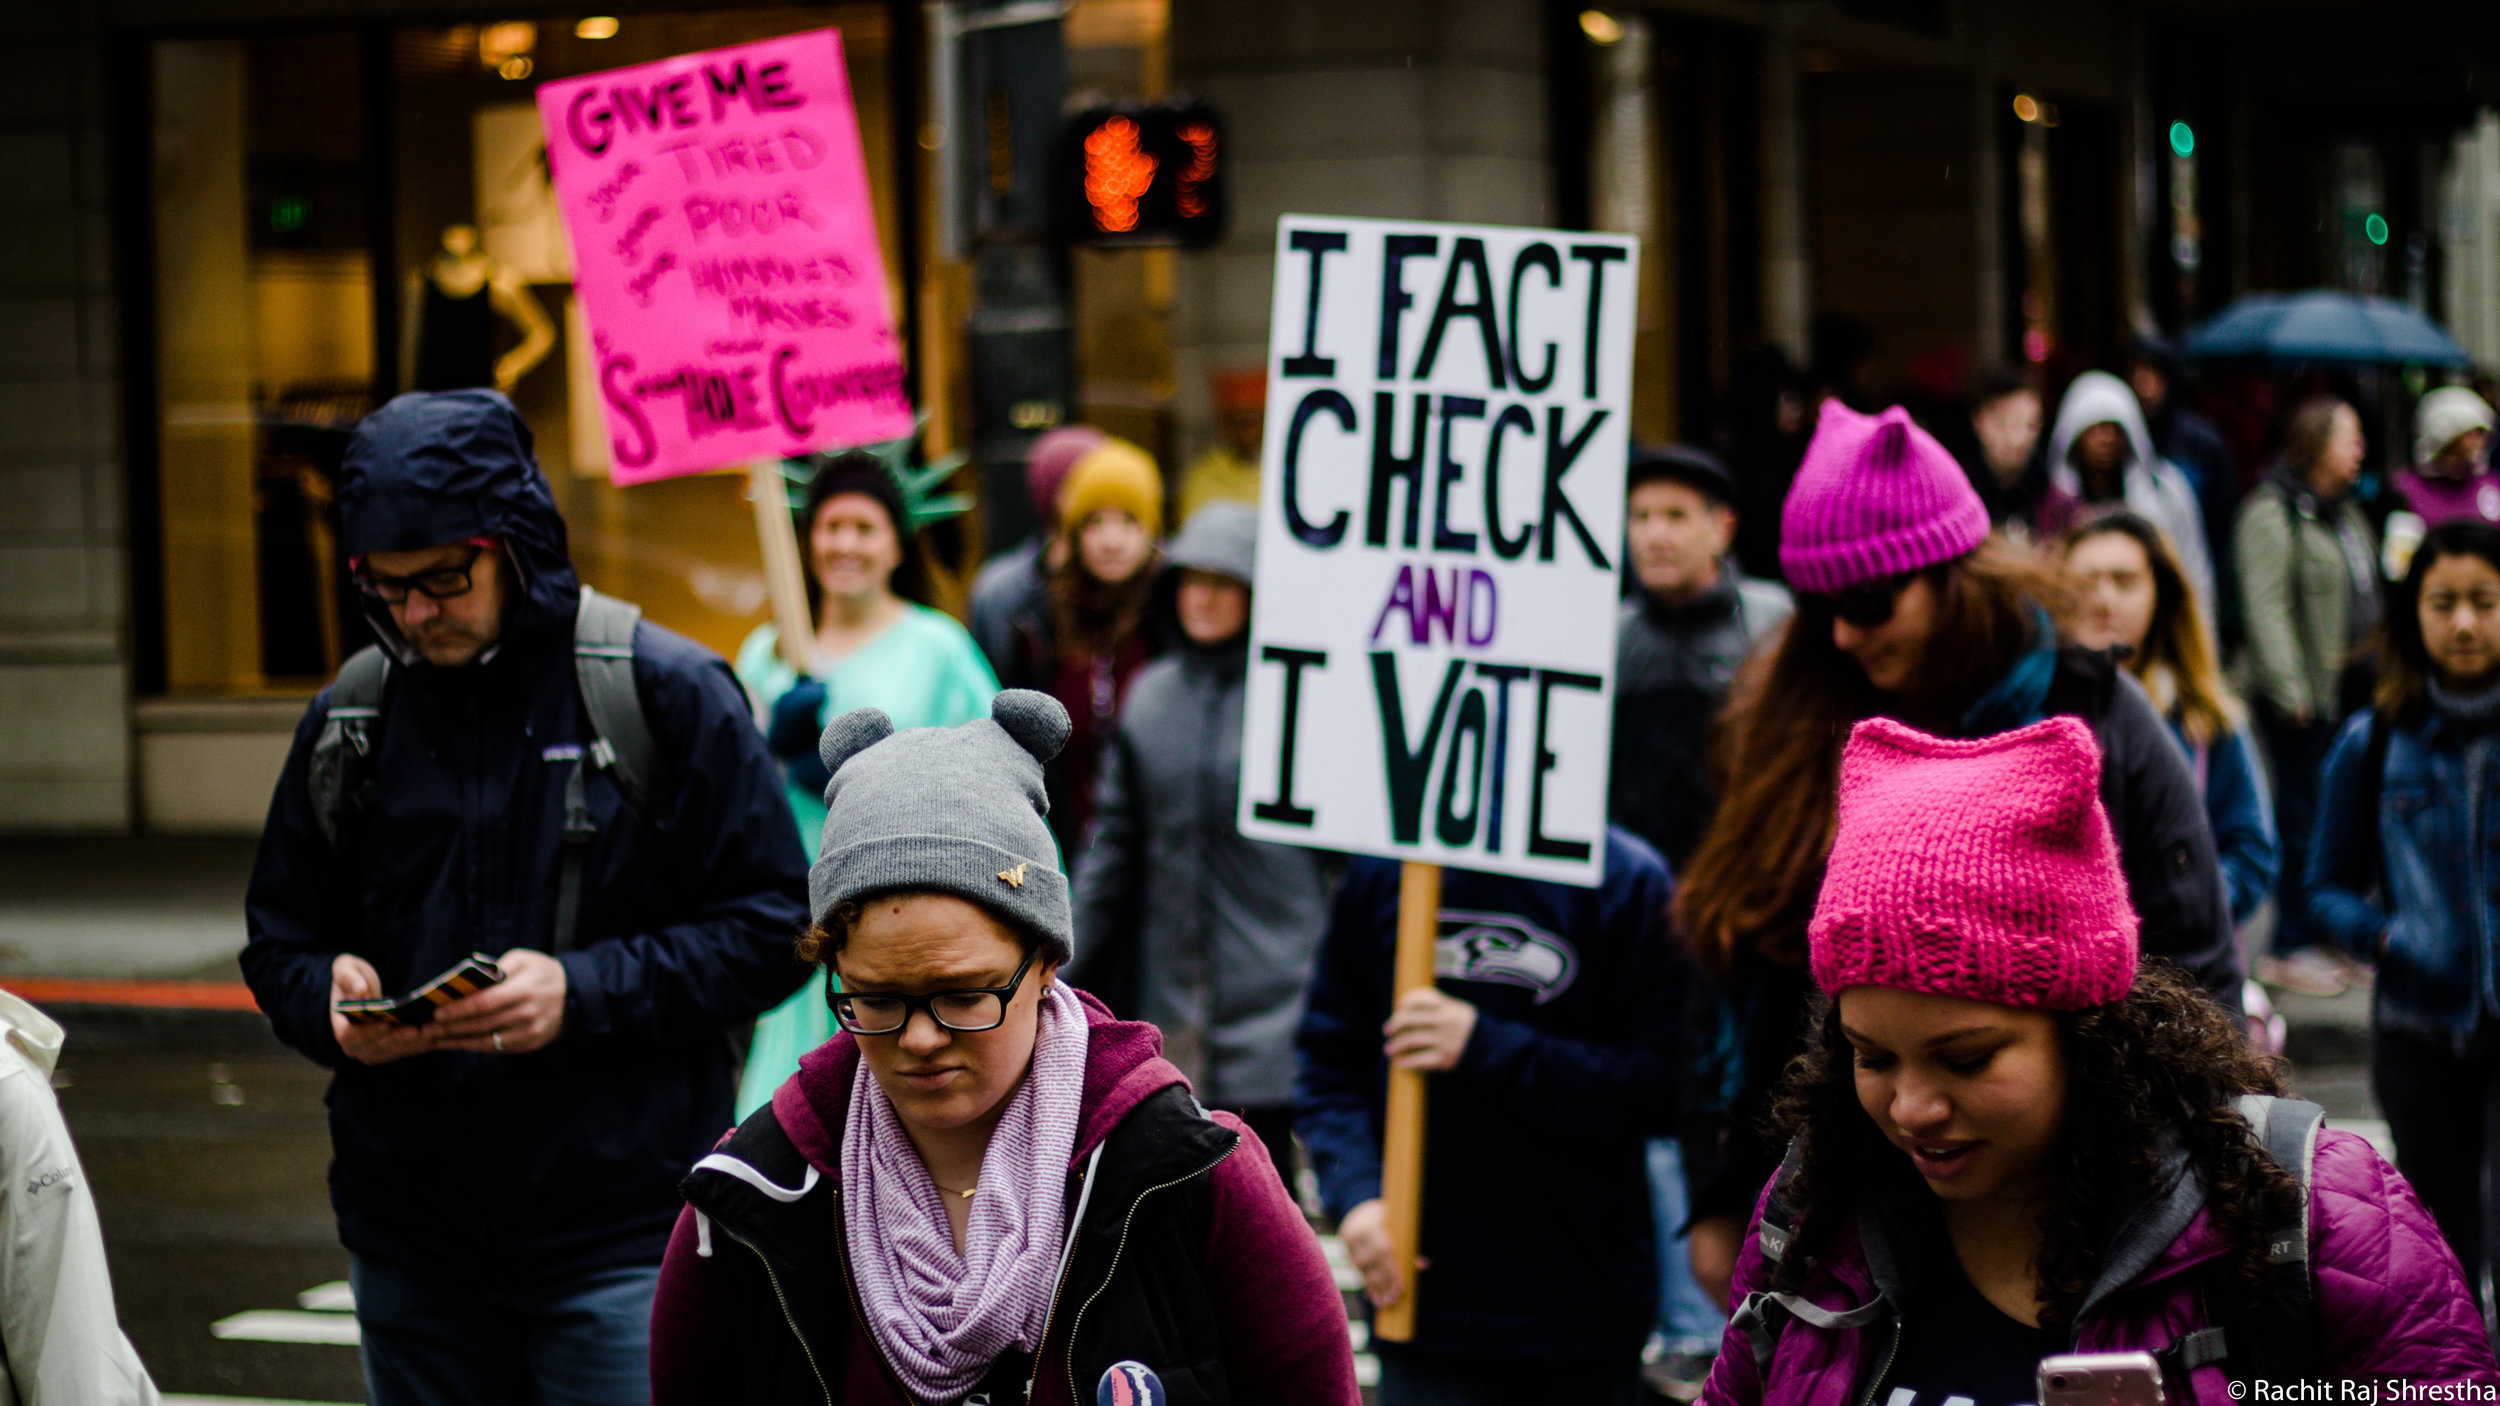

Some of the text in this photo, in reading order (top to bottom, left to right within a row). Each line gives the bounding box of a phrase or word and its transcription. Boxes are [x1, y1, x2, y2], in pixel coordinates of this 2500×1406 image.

[567, 57, 806, 159] GIVE ME
[654, 127, 830, 187] TIRED
[684, 187, 829, 247] POOR
[1281, 229, 1628, 399] I FACT
[1282, 388, 1613, 571] CHECK
[1370, 563, 1498, 647] AND
[1254, 645, 1604, 863] I VOTE
